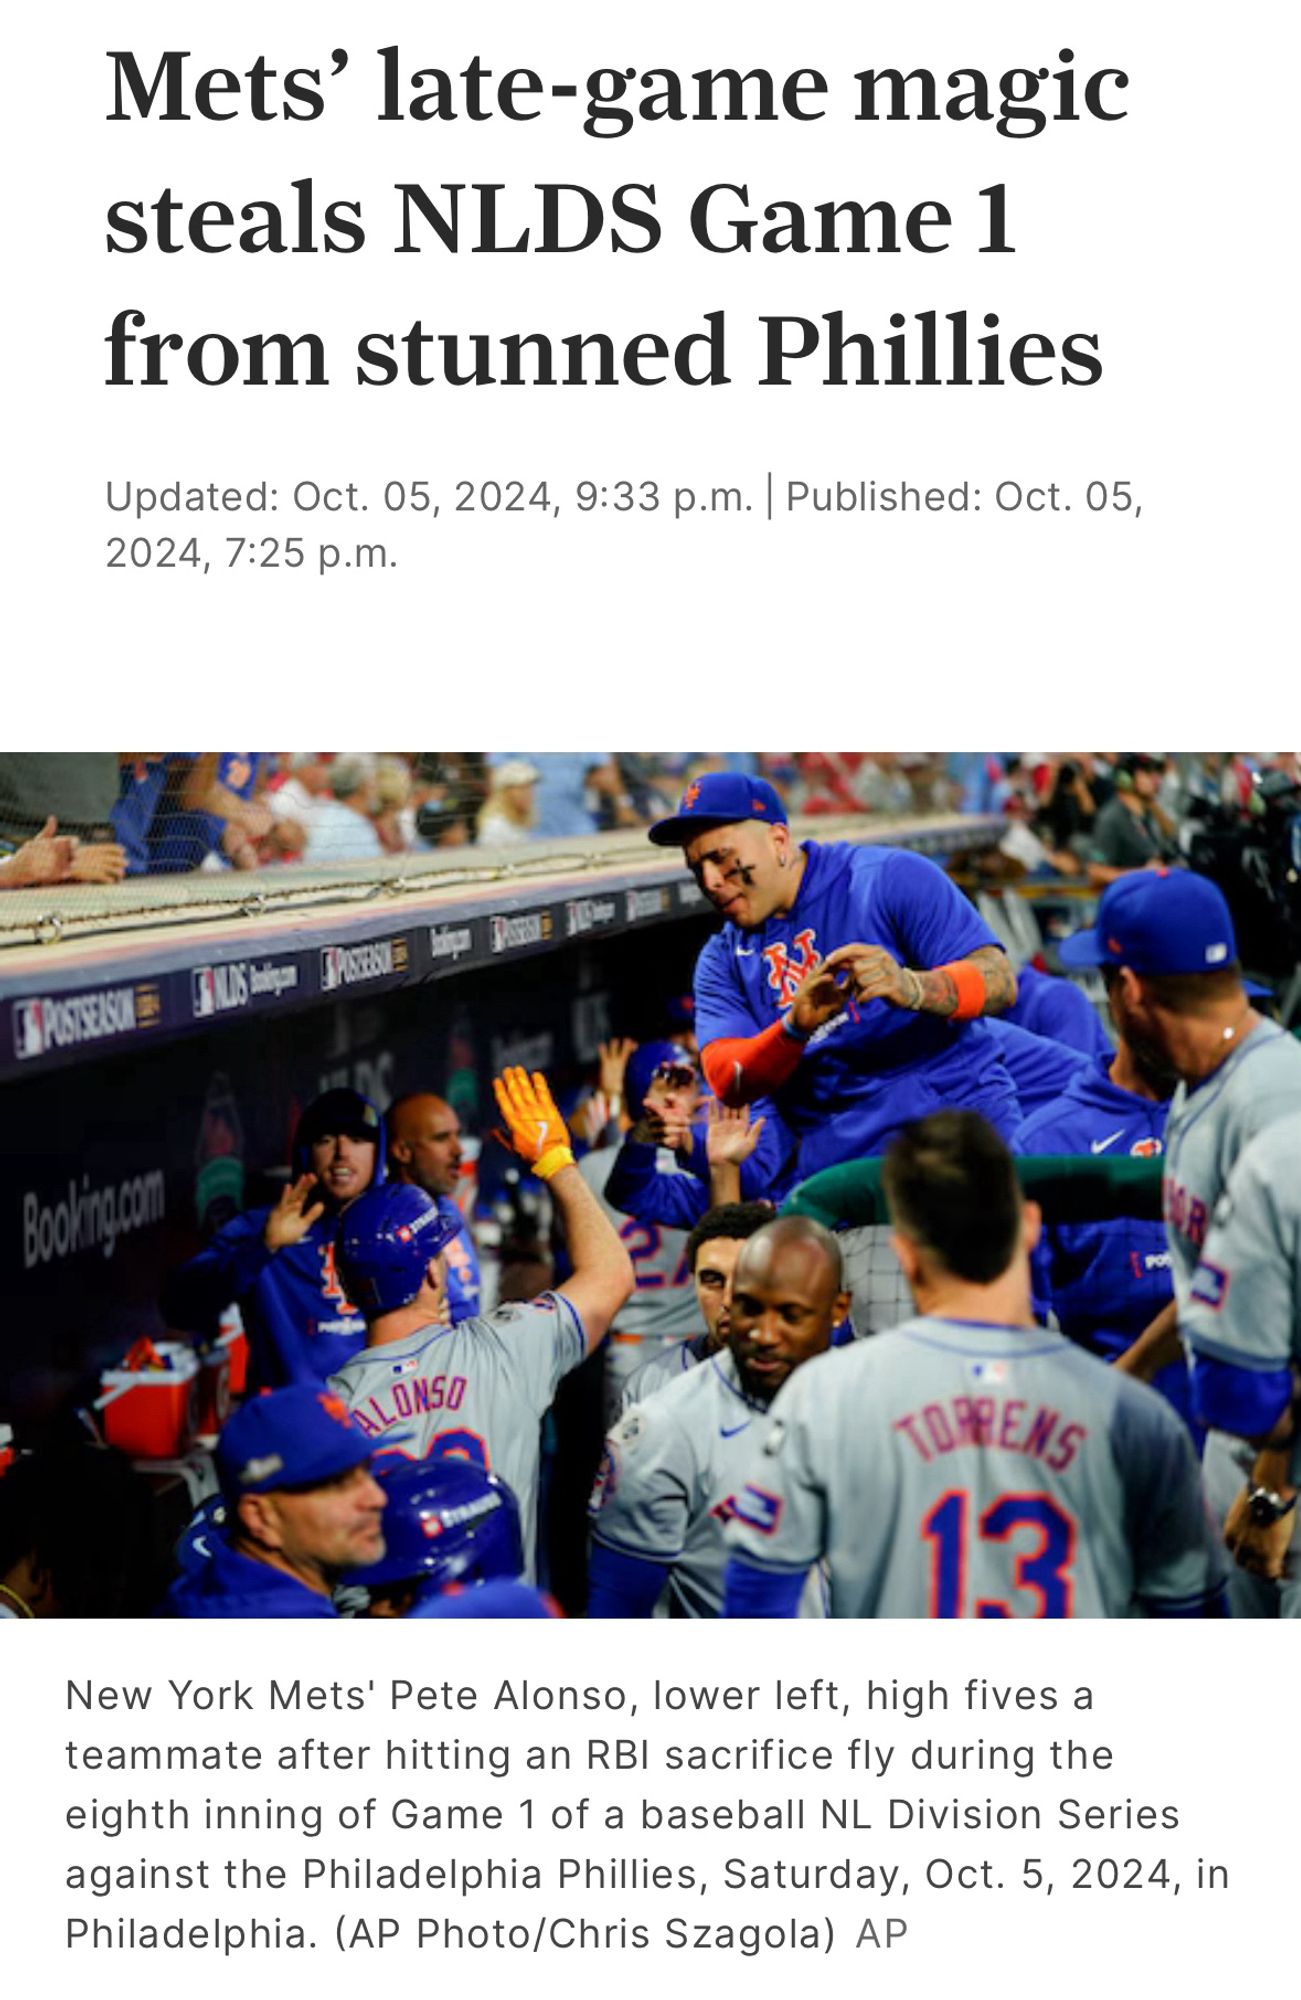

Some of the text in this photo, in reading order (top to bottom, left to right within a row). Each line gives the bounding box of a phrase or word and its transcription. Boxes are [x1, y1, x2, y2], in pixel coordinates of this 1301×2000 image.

[43, 987, 137, 1050] POSTSEASON
[22, 1168, 166, 1270] Booking.com
[352, 1375, 468, 1438] ALONSO
[893, 1395, 1087, 1473] TORRENS
[920, 1488, 1078, 1618] 13
